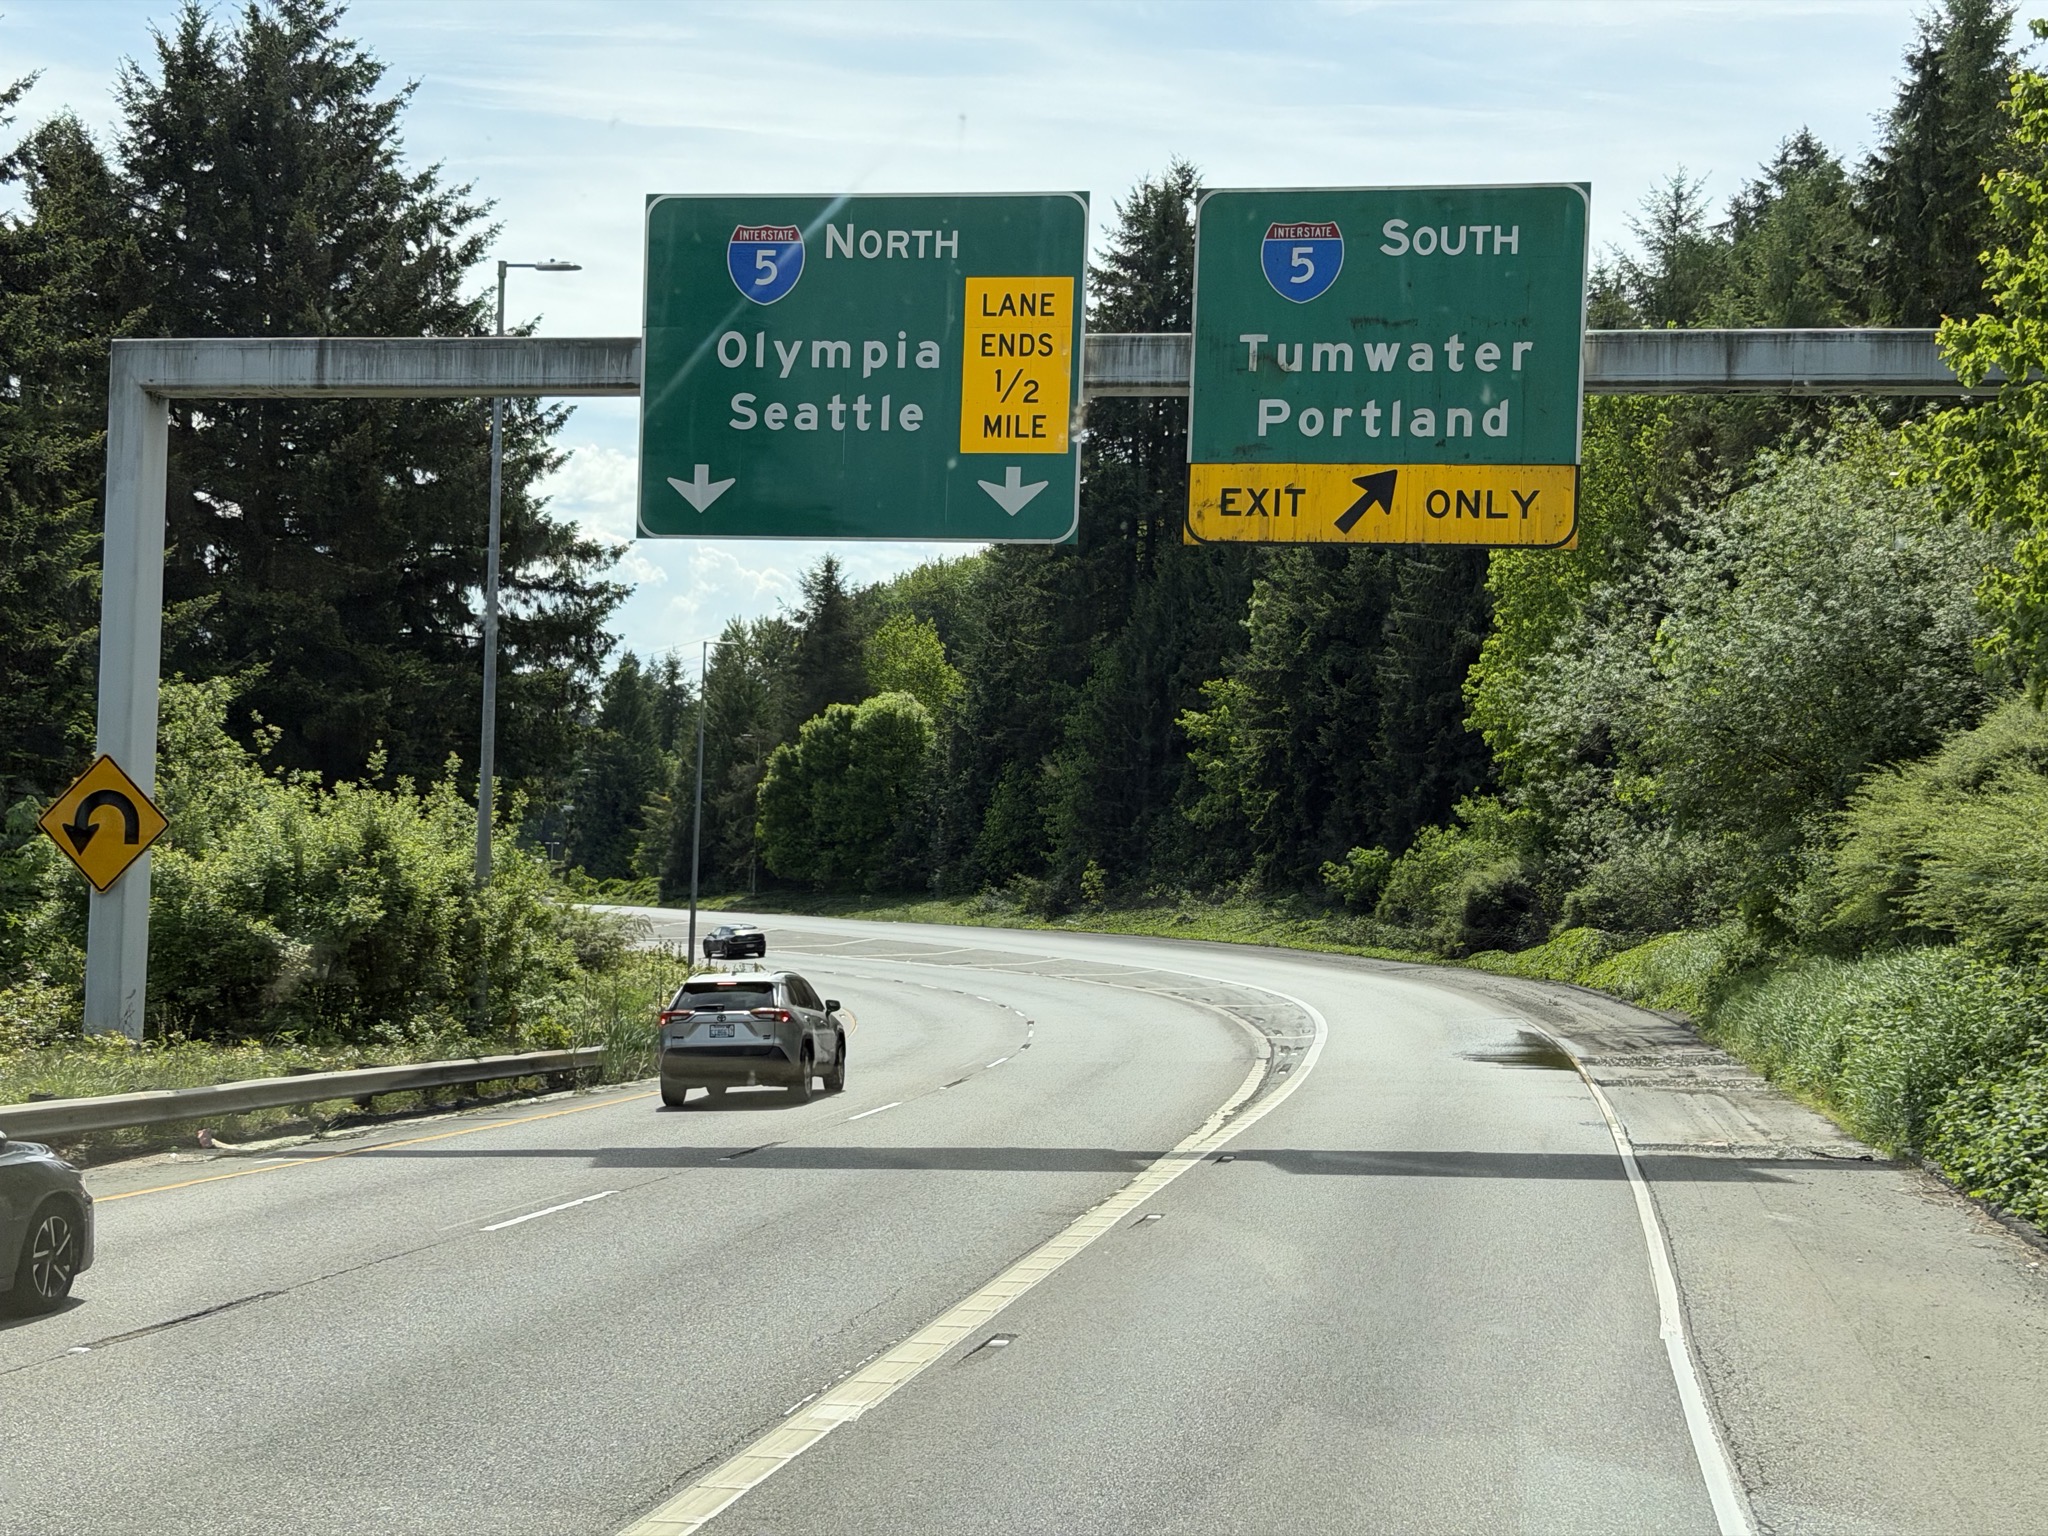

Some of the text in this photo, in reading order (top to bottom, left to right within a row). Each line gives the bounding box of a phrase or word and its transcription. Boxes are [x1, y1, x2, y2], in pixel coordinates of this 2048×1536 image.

[739, 228, 795, 242] INTERSTATE
[825, 223, 959, 259] NORTH
[1273, 226, 1332, 239] INTERSTATE
[1379, 218, 1520, 257] SOUTH
[754, 249, 778, 286] 5
[1290, 246, 1315, 284] 5
[982, 292, 1056, 317] LANE
[716, 330, 941, 379] Olympia
[980, 333, 1054, 358] ENDS
[1239, 333, 1534, 372] Tumwater
[994, 368, 1040, 404] 1/2
[728, 392, 925, 432] Seattle
[983, 414, 1047, 439] MILE
[1257, 398, 1509, 438] Portland
[1220, 487, 1541, 520] EXIT ONLY
